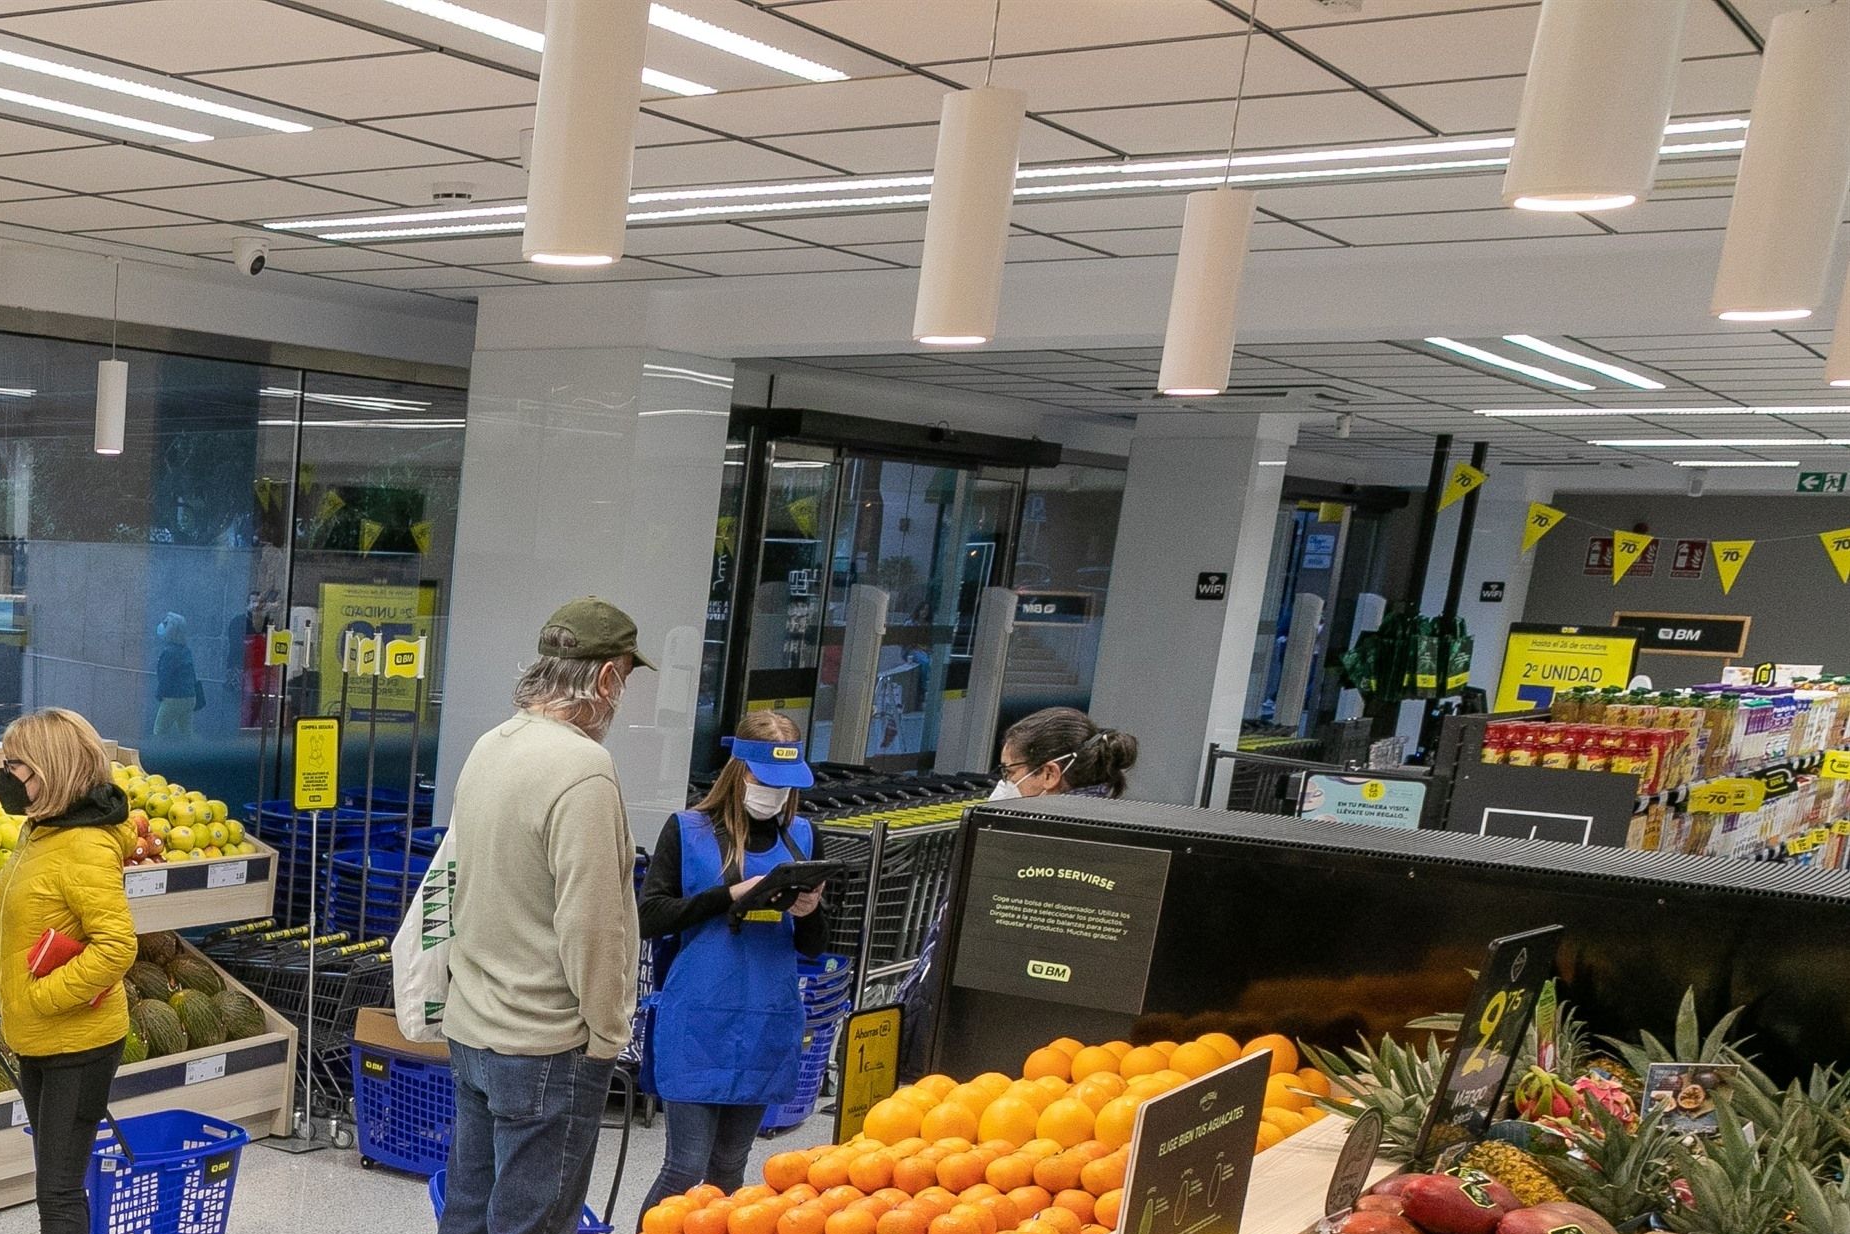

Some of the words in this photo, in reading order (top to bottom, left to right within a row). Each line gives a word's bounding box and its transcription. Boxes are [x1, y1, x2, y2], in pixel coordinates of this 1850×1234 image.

[1673, 629, 1702, 641] BM
[1541, 664, 1603, 683] UNIDAD
[1358, 803, 1388, 811] PRIMERA
[1017, 865, 1055, 879] CÓMO
[1057, 868, 1116, 891] SERVIRSE
[995, 903, 1022, 914] guantes
[1022, 906, 1038, 915] para
[1038, 907, 1076, 921] seleccionar
[1076, 913, 1087, 922] los
[1087, 915, 1124, 927] productos.
[1011, 896, 1024, 905] una
[1024, 898, 1043, 908] bolsa
[1043, 902, 1054, 910] del
[1054, 902, 1097, 915] dispensador.
[1120, 911, 1131, 920] los
[995, 917, 1025, 930] etiquetar
[1033, 923, 1065, 935] producto.
[1066, 927, 1092, 939] Muchas
[1092, 931, 1119, 942] gracias.
[1029, 916, 1046, 924] zona
[1056, 918, 1087, 930] balanzas
[1086, 922, 1103, 932] para
[1102, 925, 1123, 935] pesar
[1045, 965, 1067, 979] BM
[854, 1028, 879, 1041] Ahorras
[1451, 1086, 1488, 1109] Mango
[1178, 1129, 1195, 1148] BIEN
[1195, 1122, 1208, 1140] TUS
[1207, 1105, 1245, 1133] AGUACATES
